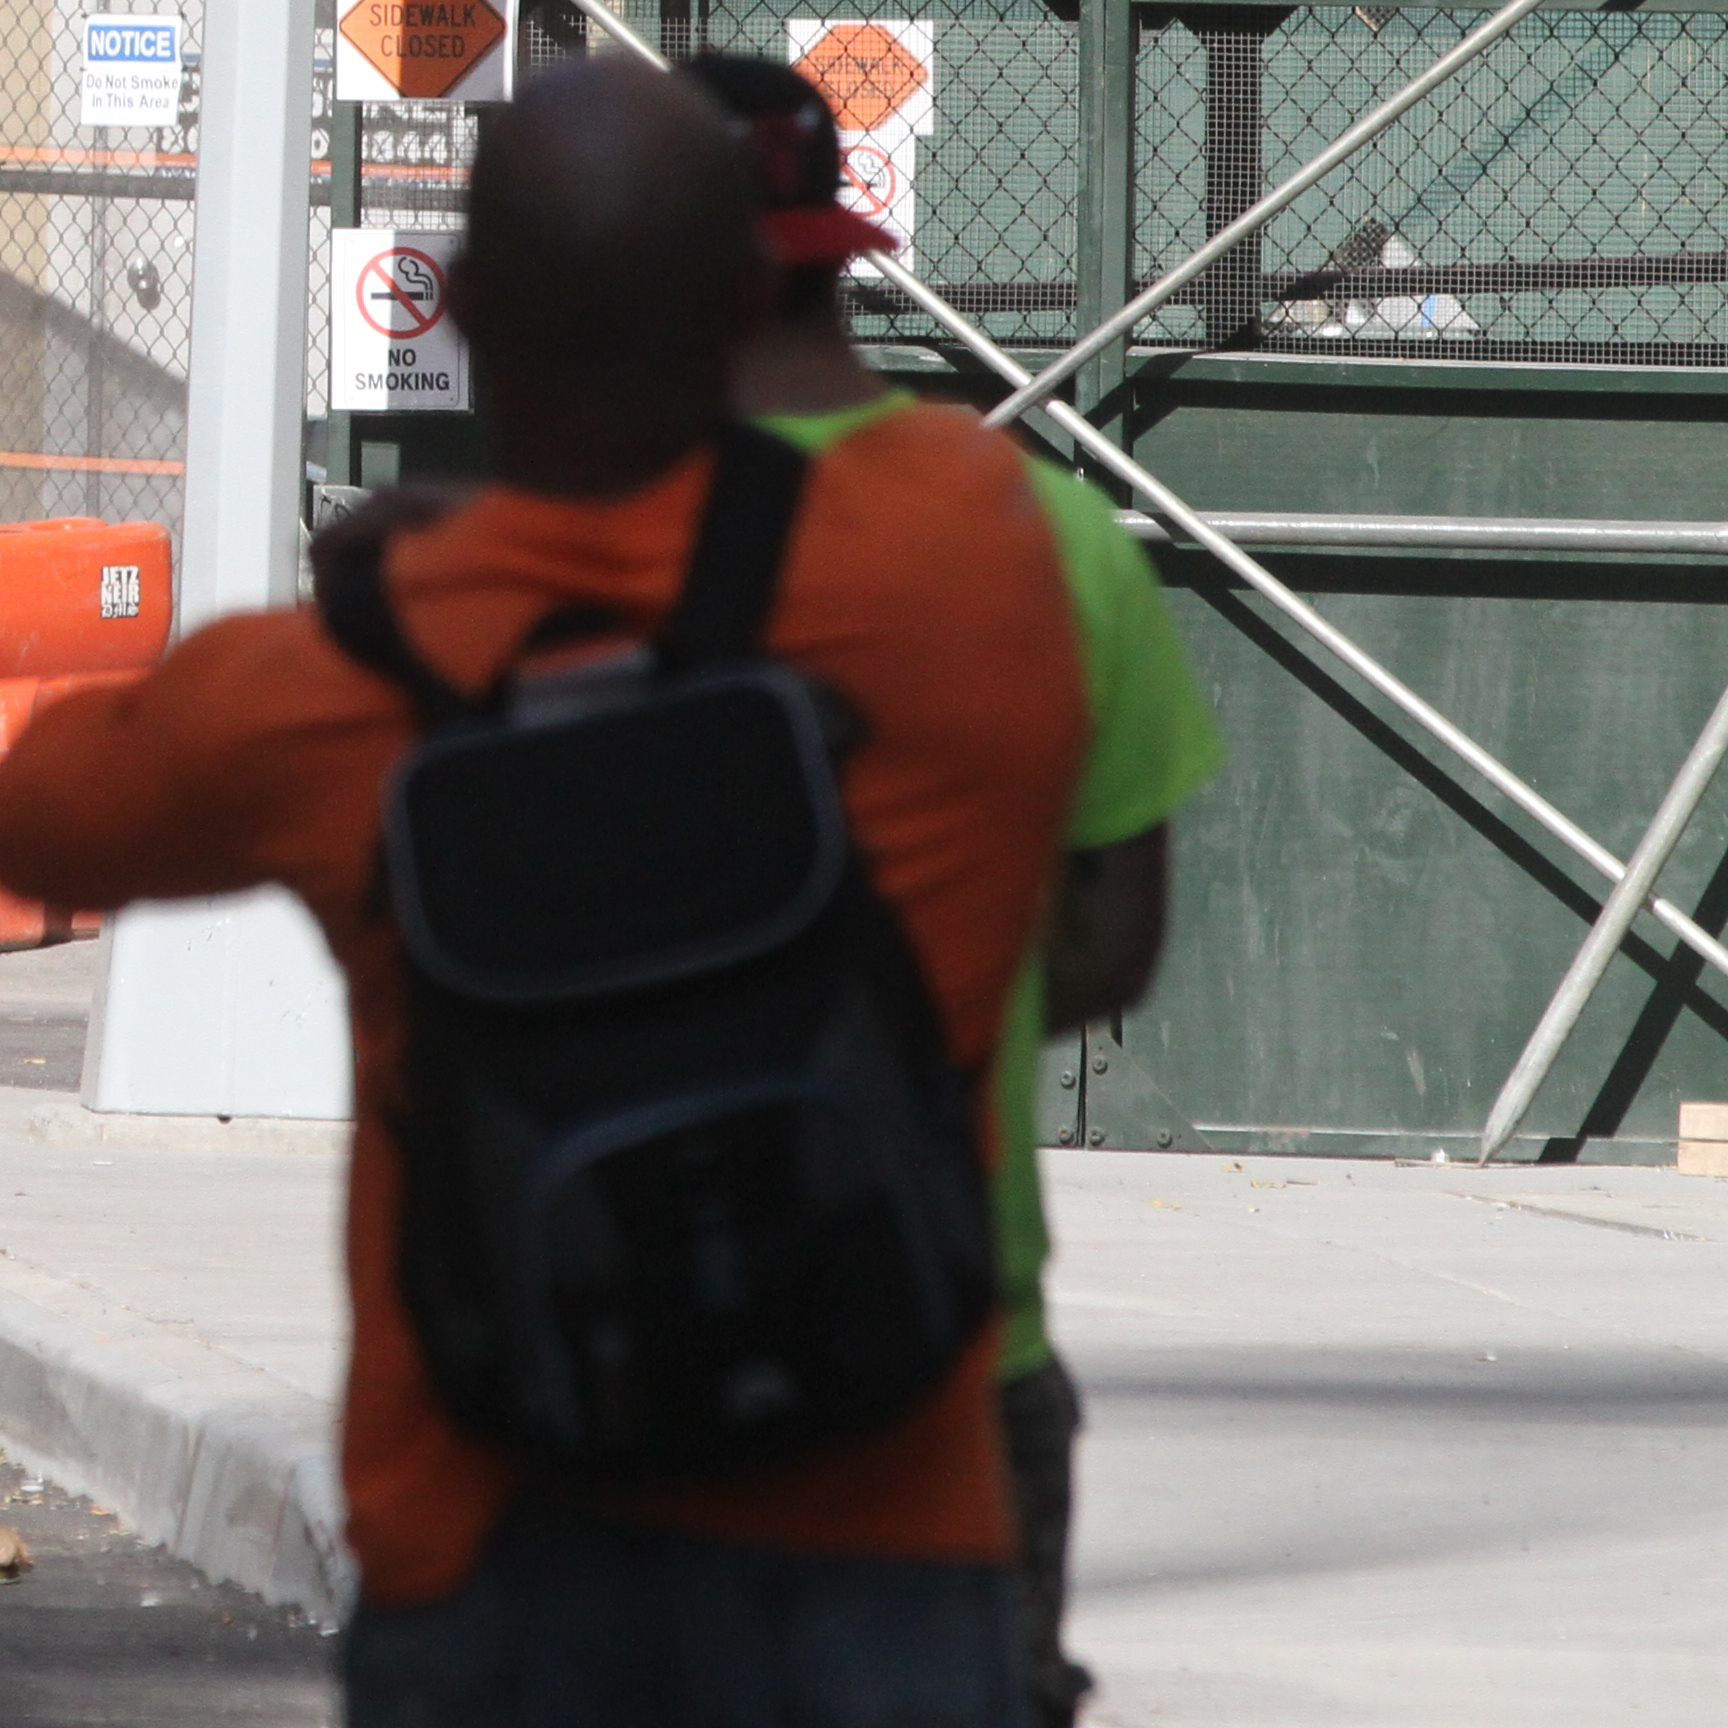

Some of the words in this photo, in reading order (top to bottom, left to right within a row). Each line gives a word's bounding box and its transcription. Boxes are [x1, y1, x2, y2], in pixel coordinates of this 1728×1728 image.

[370, 3, 476, 27] SIDEWALK
[91, 30, 171, 57] NOTICE
[381, 34, 465, 58] CLOSED
[86, 74, 102, 89] Do
[106, 74, 126, 89] Not
[131, 74, 179, 90] Smoke
[92, 93, 102, 109] In
[106, 93, 134, 109] This
[139, 94, 170, 109] Area
[388, 348, 417, 367] NO
[355, 372, 450, 391] SMOKING
